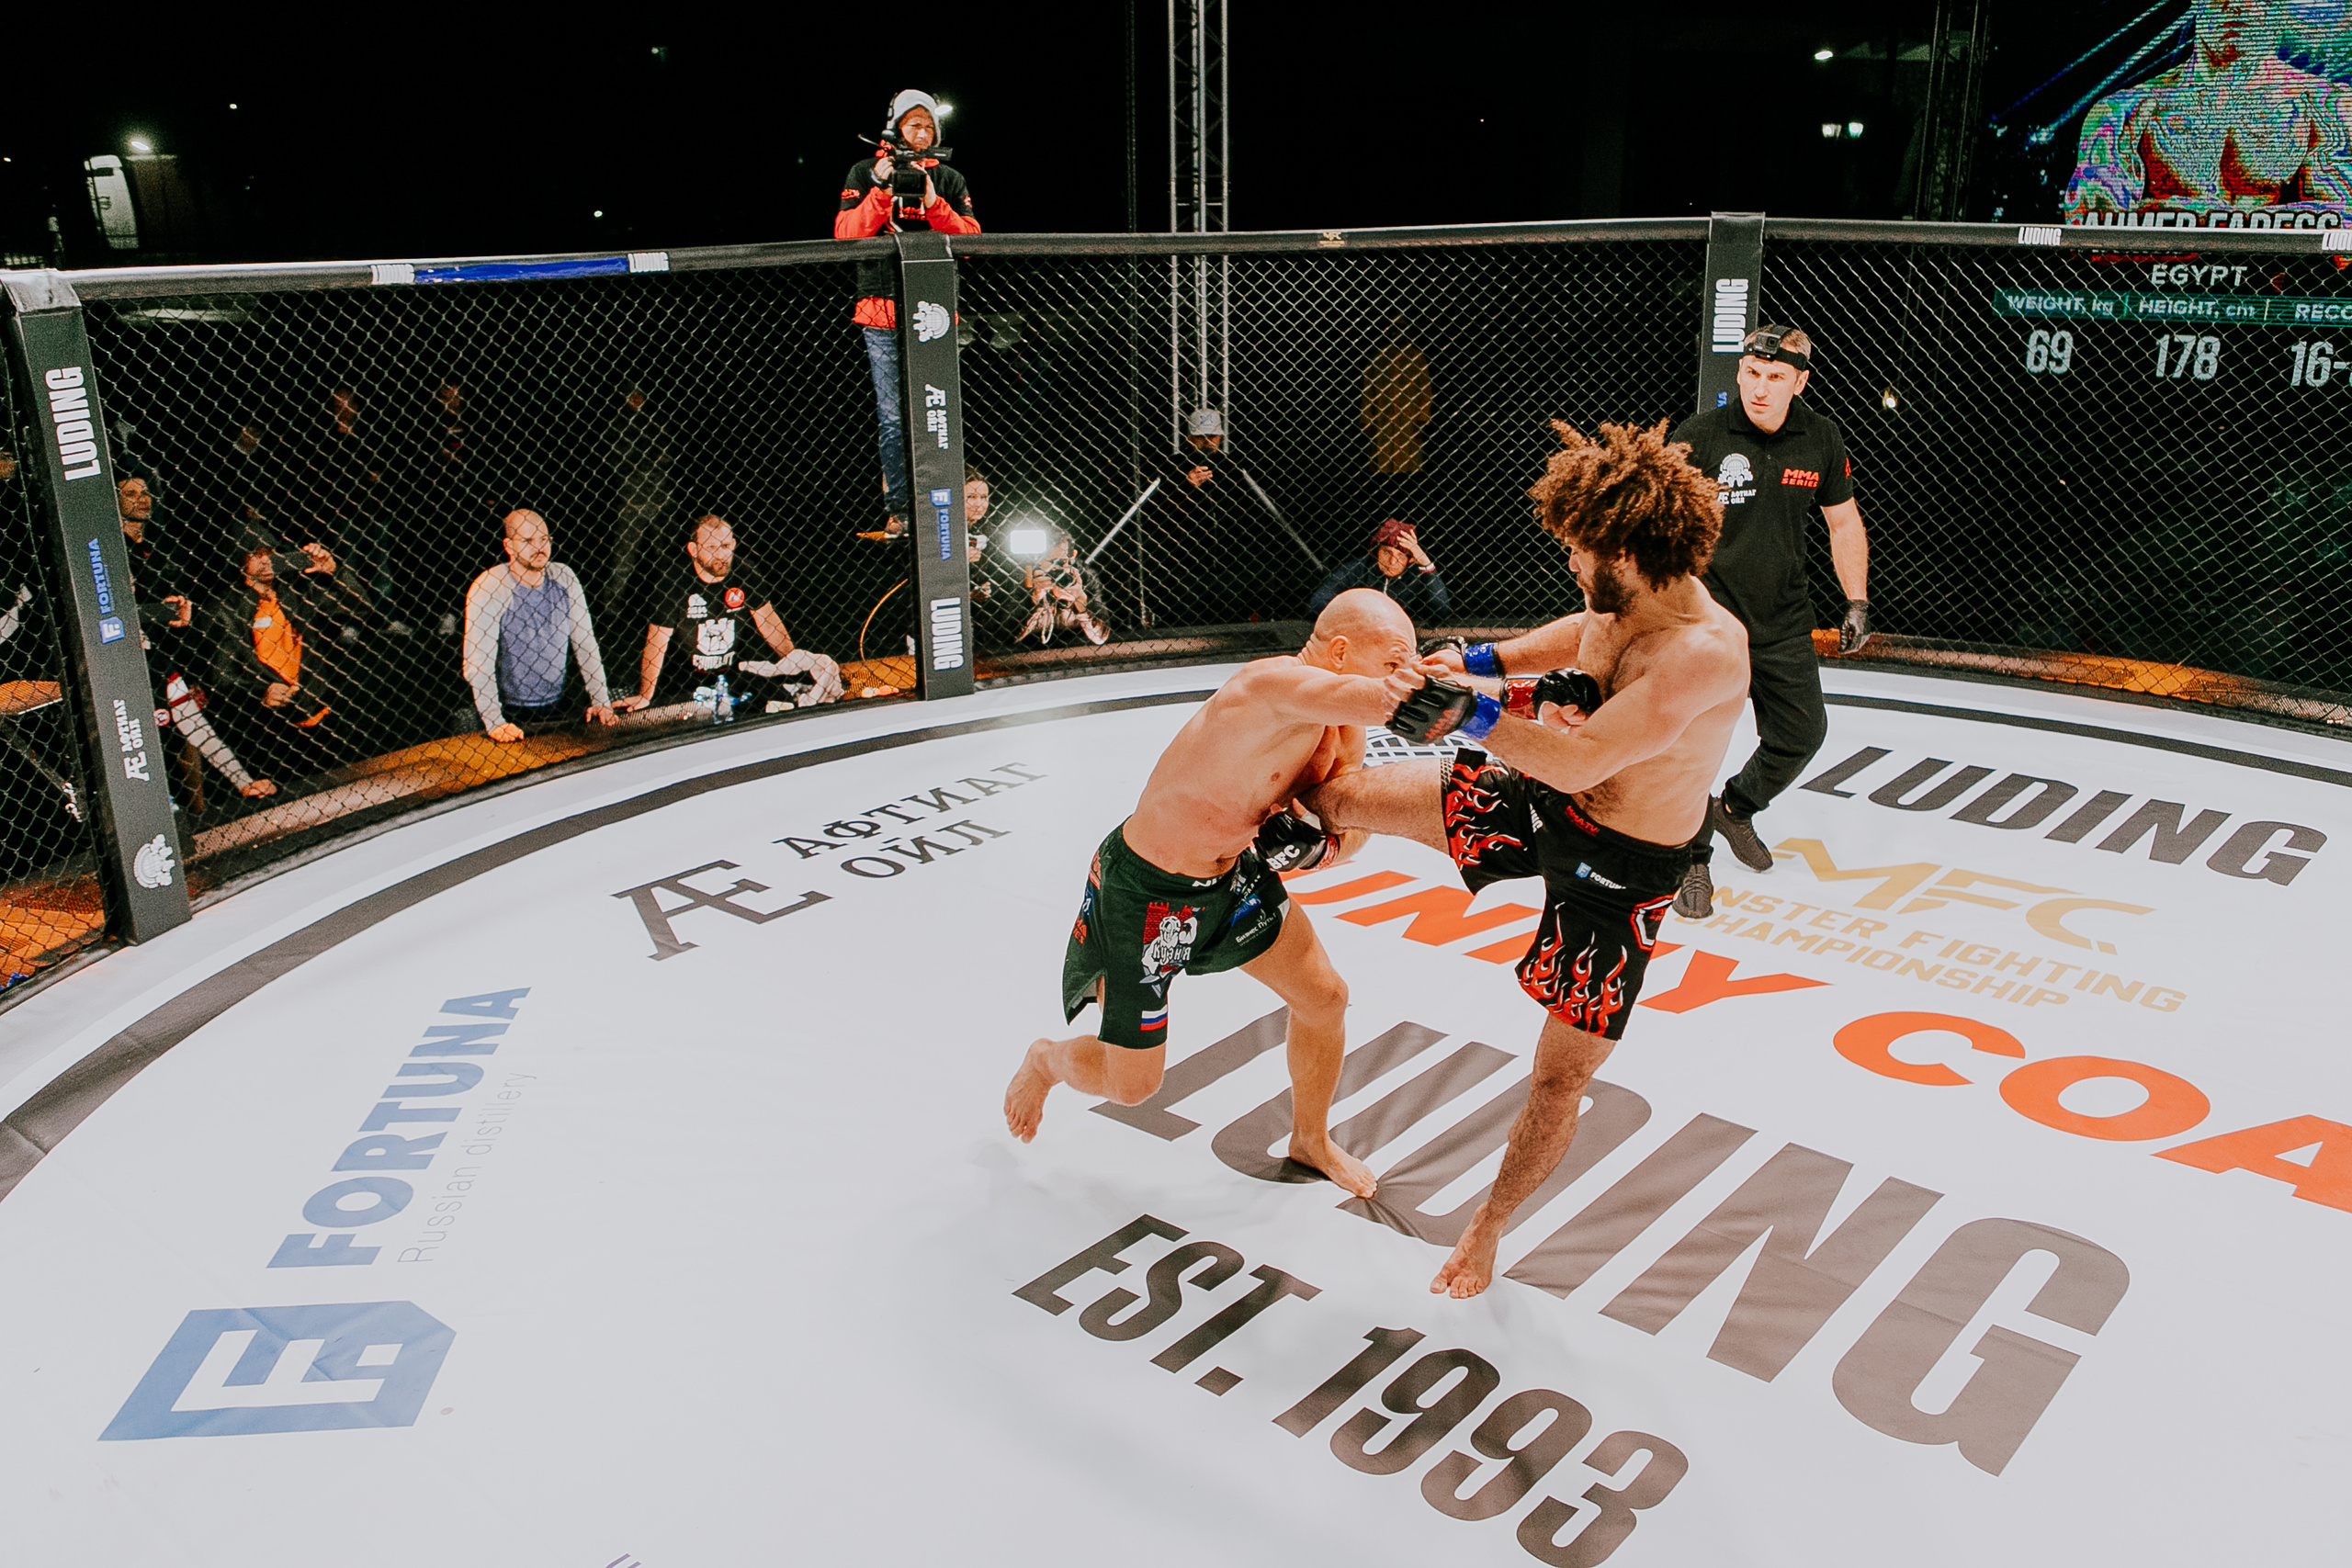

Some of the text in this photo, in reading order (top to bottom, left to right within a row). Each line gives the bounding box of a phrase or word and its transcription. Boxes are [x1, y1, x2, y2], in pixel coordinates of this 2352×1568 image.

[2018, 226, 2062, 246] LUDING
[2008, 295, 2113, 315] WEIGHT, kg
[2139, 299, 2255, 318] HEIGHT, cm
[2151, 265, 2247, 287] EGYPT
[1712, 278, 1748, 353] LUDING
[2026, 330, 2074, 374] 69
[2155, 334, 2221, 380] 178
[45, 367, 101, 480] LUDING
[1781, 479, 1818, 488] SERIES
[1782, 468, 1819, 481] MMA
[939, 508, 952, 561] FORTUNA
[87, 537, 111, 615] FORTUNA
[930, 597, 965, 671] LUDING
[771, 761, 1049, 859] АФТИАГ
[1798, 747, 2328, 886] LUDING
[840, 819, 1014, 878] ОЙЛ
[1772, 837, 2157, 955] MFC
[1896, 931, 2188, 1013] FIGHTING
[266, 987, 532, 1269] FORTUNA
[397, 1072, 537, 1263] Russian distillery
[1087, 1001, 2131, 1477] LUDING
[1011, 1213, 1689, 1568] EST. 1993
